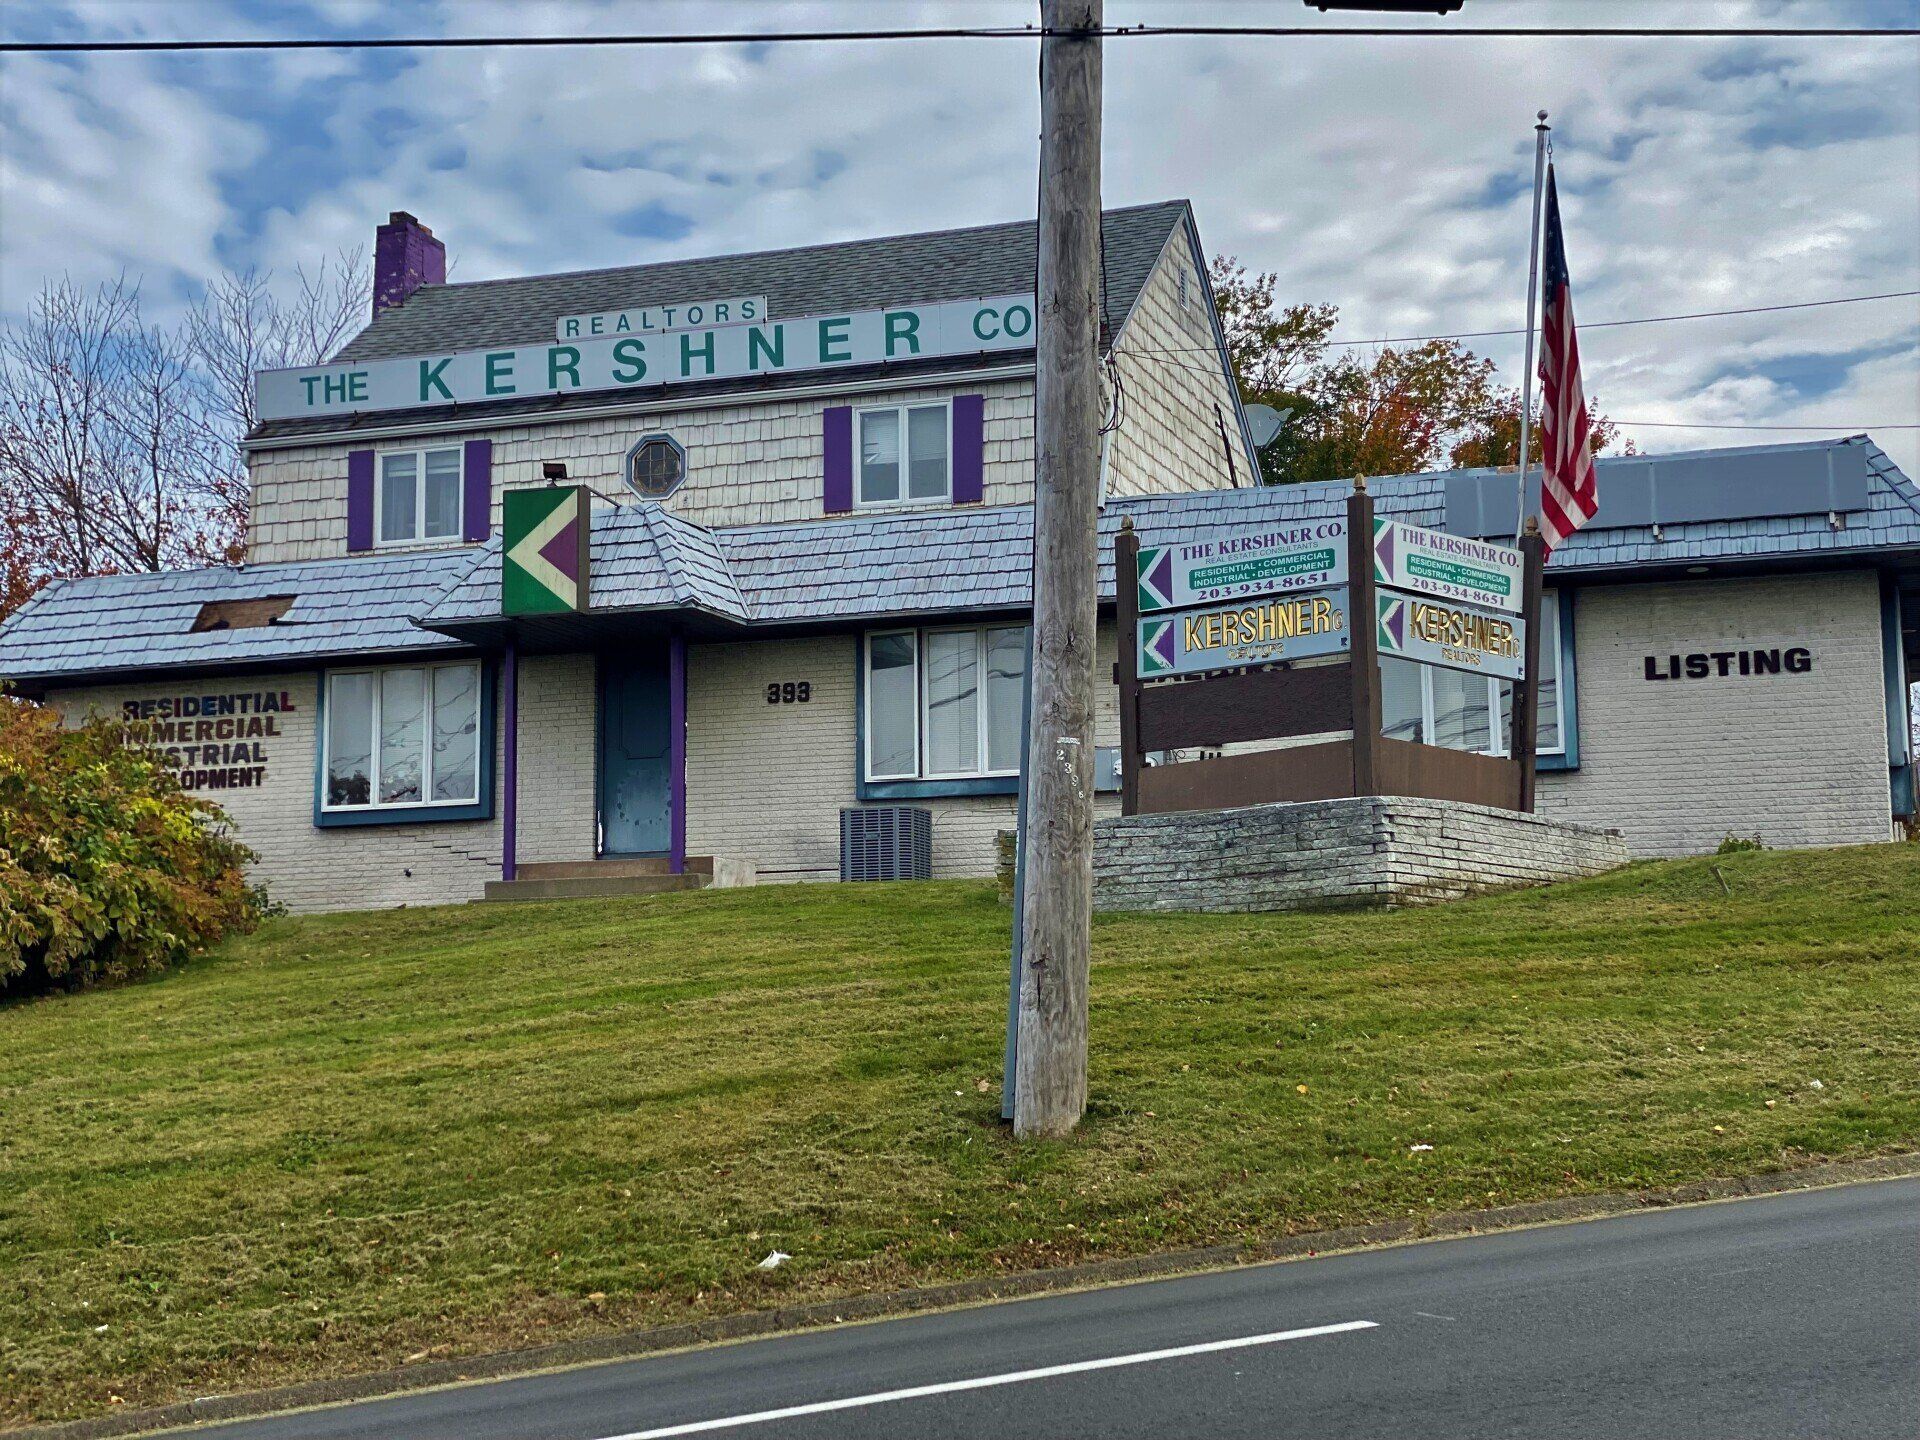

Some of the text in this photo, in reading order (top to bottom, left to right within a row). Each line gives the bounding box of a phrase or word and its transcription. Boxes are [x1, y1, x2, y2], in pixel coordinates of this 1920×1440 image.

[565, 300, 756, 338] REALTORS
[299, 305, 1032, 406] THE KERSHNER CO
[1180, 522, 1347, 561] THE KERSHNER CO.
[1205, 542, 1319, 565] REAL ESTATE CONSULTANTS
[1400, 528, 1520, 568] THE KERSHNER CO.
[1194, 551, 1330, 578] RESIDENTIAL COMMERCIAL
[1410, 556, 1507, 584] RESIDENTIAL COMMERCIAL
[1419, 547, 1501, 571] REAL ESTATE CONSULTANTS
[1194, 560, 1330, 587] INDUSTRIAL DEVELOPMENT
[1197, 572, 1329, 600] 203-934-8651
[1410, 565, 1507, 593] INDUSTRIAL DEVELOPMENT
[1411, 577, 1505, 606] 203-934-8651
[1183, 596, 1332, 655] KERSHNER
[1410, 601, 1513, 658] KERSHNER
[1442, 647, 1481, 667] REALTORS
[1644, 647, 1812, 681] LISTING
[123, 691, 295, 721] RESIDENTIAL
[767, 681, 810, 704] 393
[171, 766, 265, 790] OPMENT
